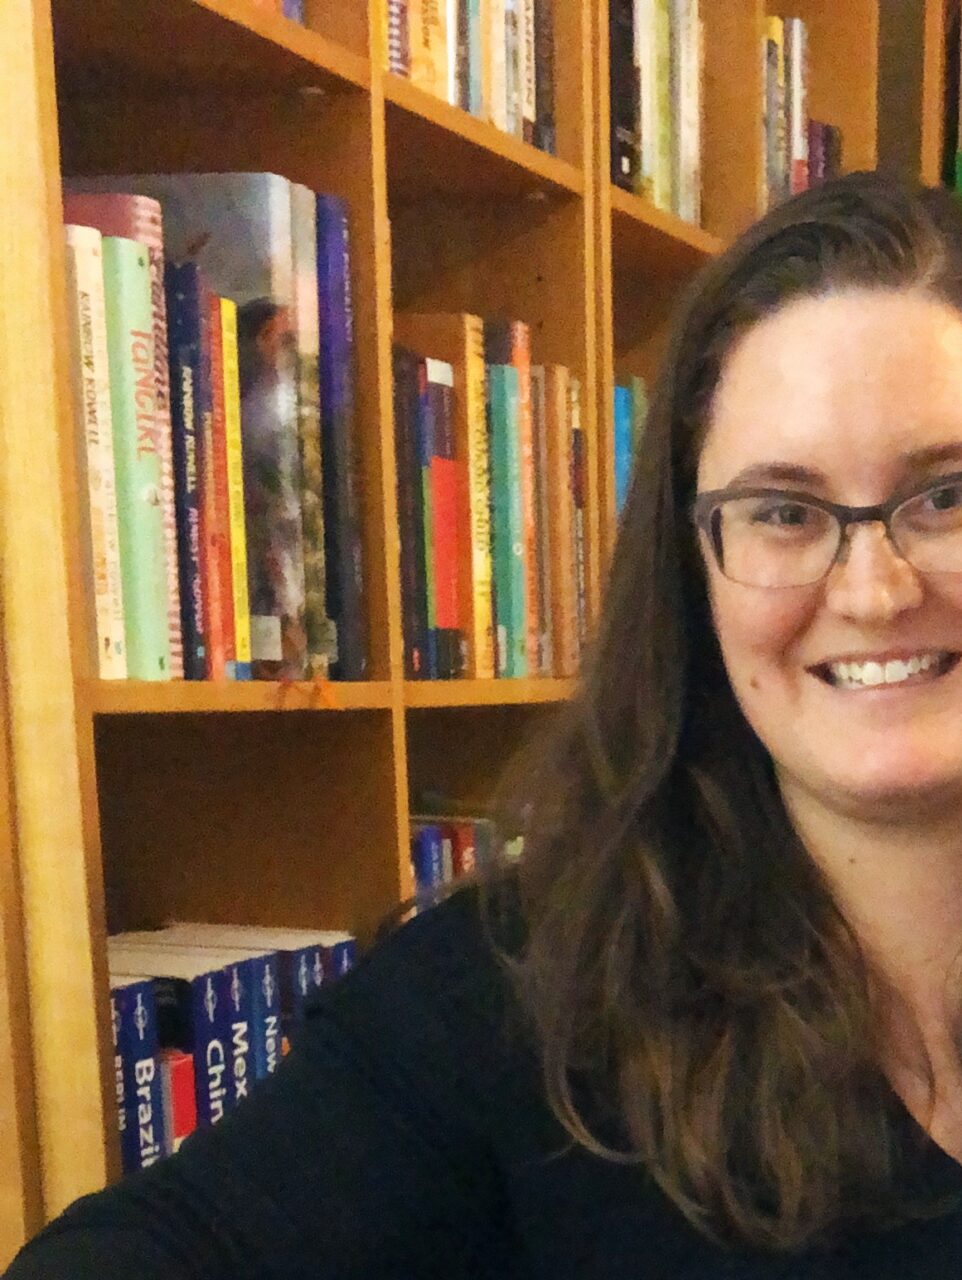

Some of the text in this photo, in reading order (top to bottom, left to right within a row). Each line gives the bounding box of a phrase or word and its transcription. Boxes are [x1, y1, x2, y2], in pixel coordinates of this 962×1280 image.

[79, 290, 99, 445] RAINBOW ROWELL
[181, 365, 194, 431] RAINBOW
[184, 434, 197, 494] ROWELL
[232, 1021, 249, 1098] Mex
[265, 1016, 278, 1073] New
[135, 1057, 160, 1167] Brazil
